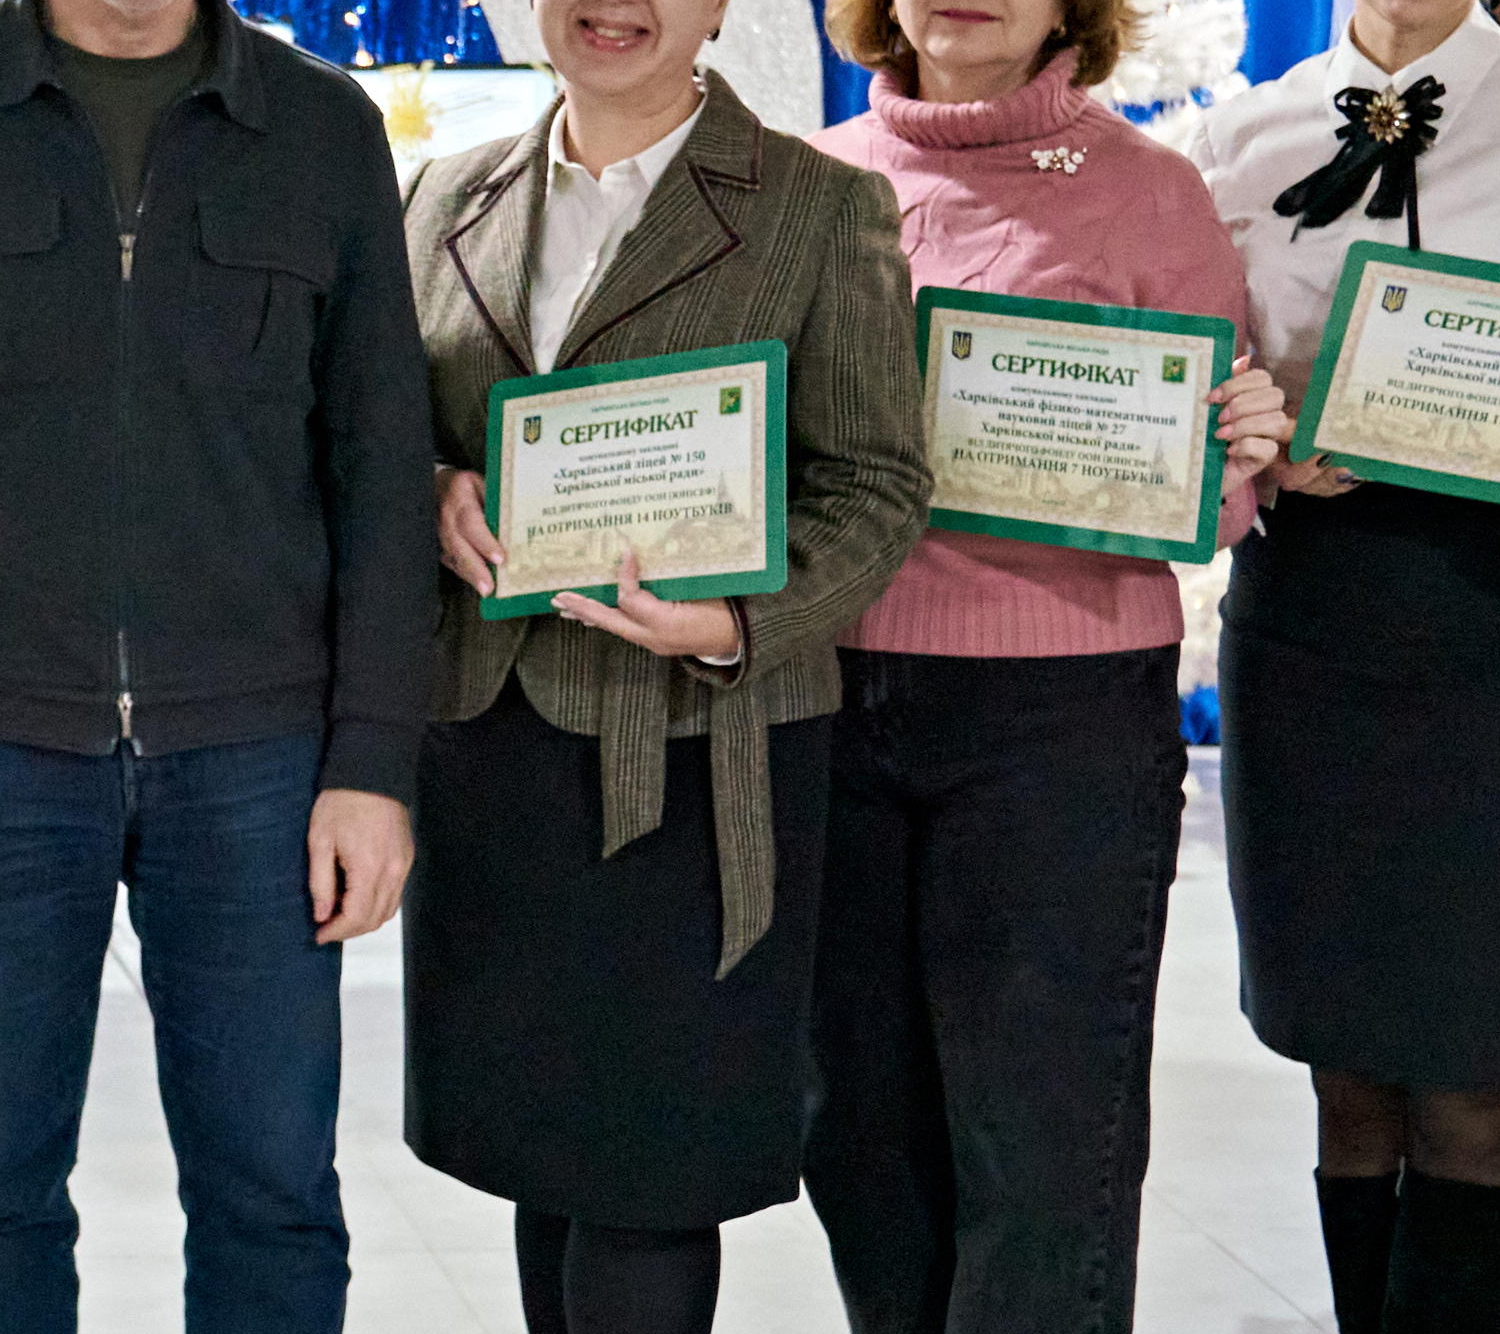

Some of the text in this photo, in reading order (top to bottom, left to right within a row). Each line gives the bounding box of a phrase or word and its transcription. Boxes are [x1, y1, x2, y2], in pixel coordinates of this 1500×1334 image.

[991, 353, 1139, 387] СЕРТИФІКАТ
[998, 411, 1055, 427] науковий
[1059, 418, 1092, 431] ліцей
[1389, 395, 1489, 422] ОТРИМАННЯ
[560, 409, 698, 446] СЕРТИФІКАТ
[686, 450, 706, 463] 150
[976, 451, 1067, 473] ОТРИМАННЯ
[1081, 464, 1164, 485] НОУТБУКІВ
[547, 513, 632, 535] ОТРИМАННЯ
